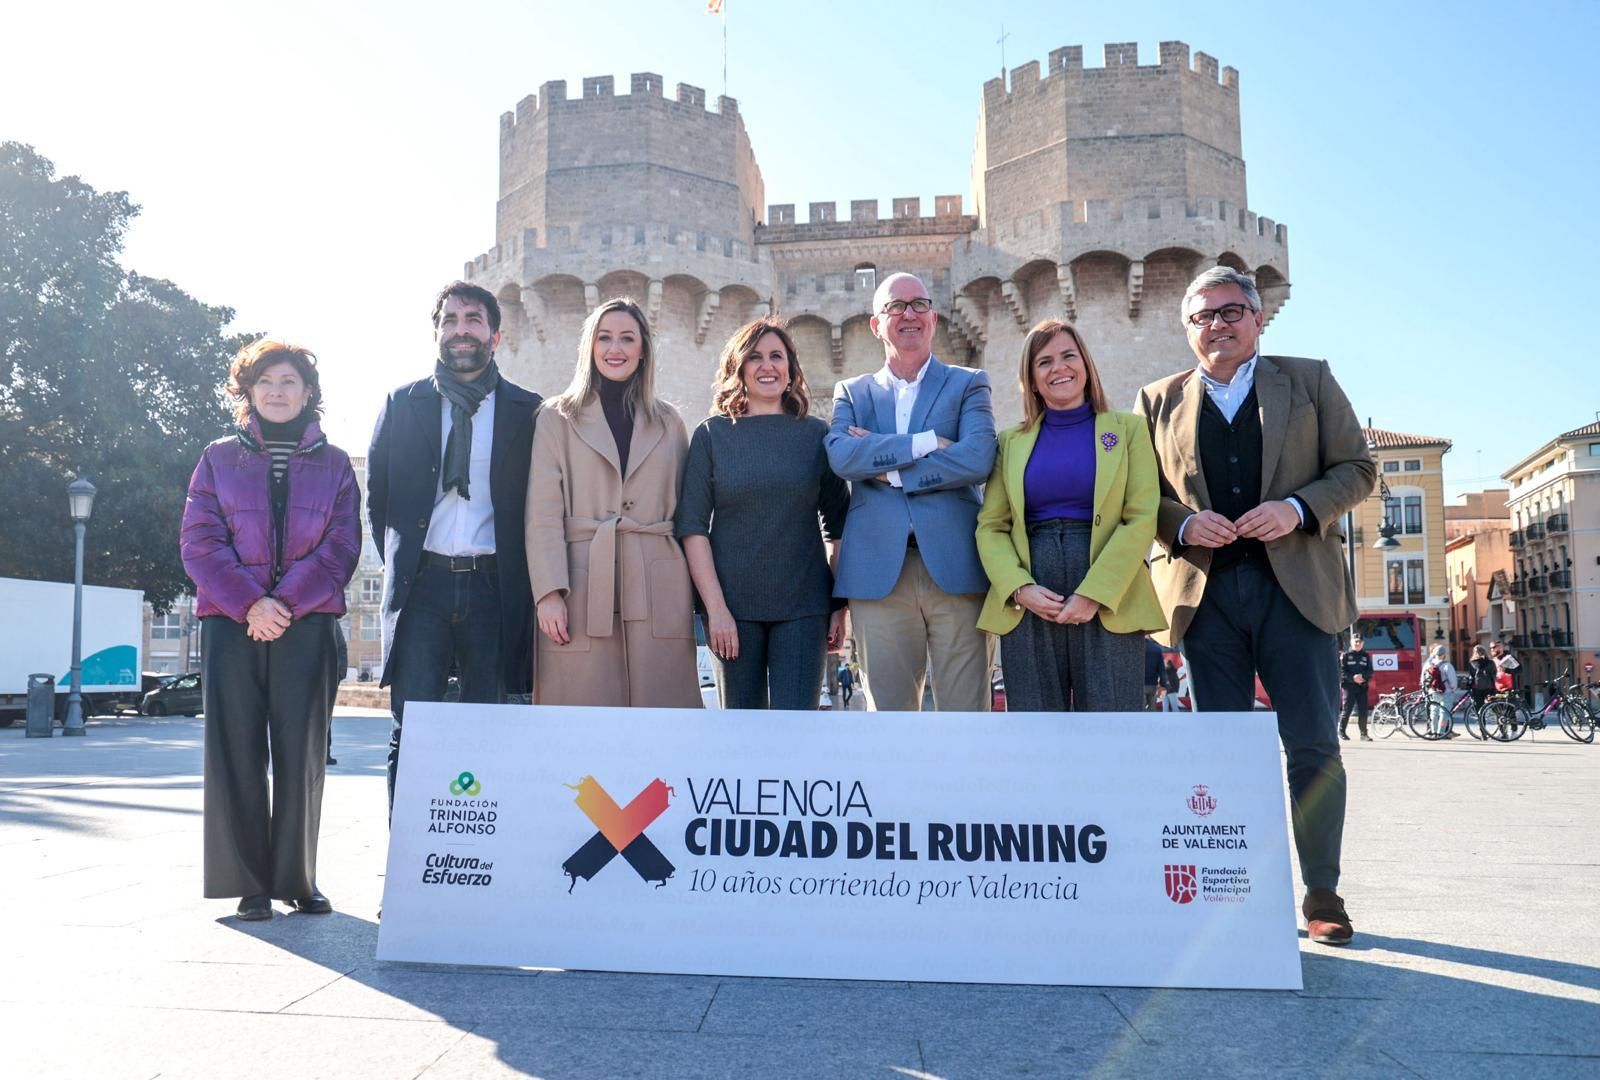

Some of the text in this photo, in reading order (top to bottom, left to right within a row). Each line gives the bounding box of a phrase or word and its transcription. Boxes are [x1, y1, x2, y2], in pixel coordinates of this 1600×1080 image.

[1377, 658, 1394, 667] GO
[431, 798, 499, 809] FUNDACIÓN
[686, 777, 873, 818] VALENCIA
[430, 809, 498, 822] TRINIDAD
[428, 822, 496, 835] ALFONSO
[1162, 825, 1247, 836] AJUNTAMENT
[685, 818, 1108, 864] CIUDAD DEL RUNNING
[1162, 836, 1248, 850] DE VALÈNCIA
[425, 853, 493, 870] Cultura del
[422, 869, 492, 886] Esfuerzo
[1202, 866, 1247, 876] Fundació
[688, 868, 1080, 904] 10 años corriendo por Valencia
[1202, 875, 1250, 886] Esportiva
[1203, 885, 1251, 895] Municipal
